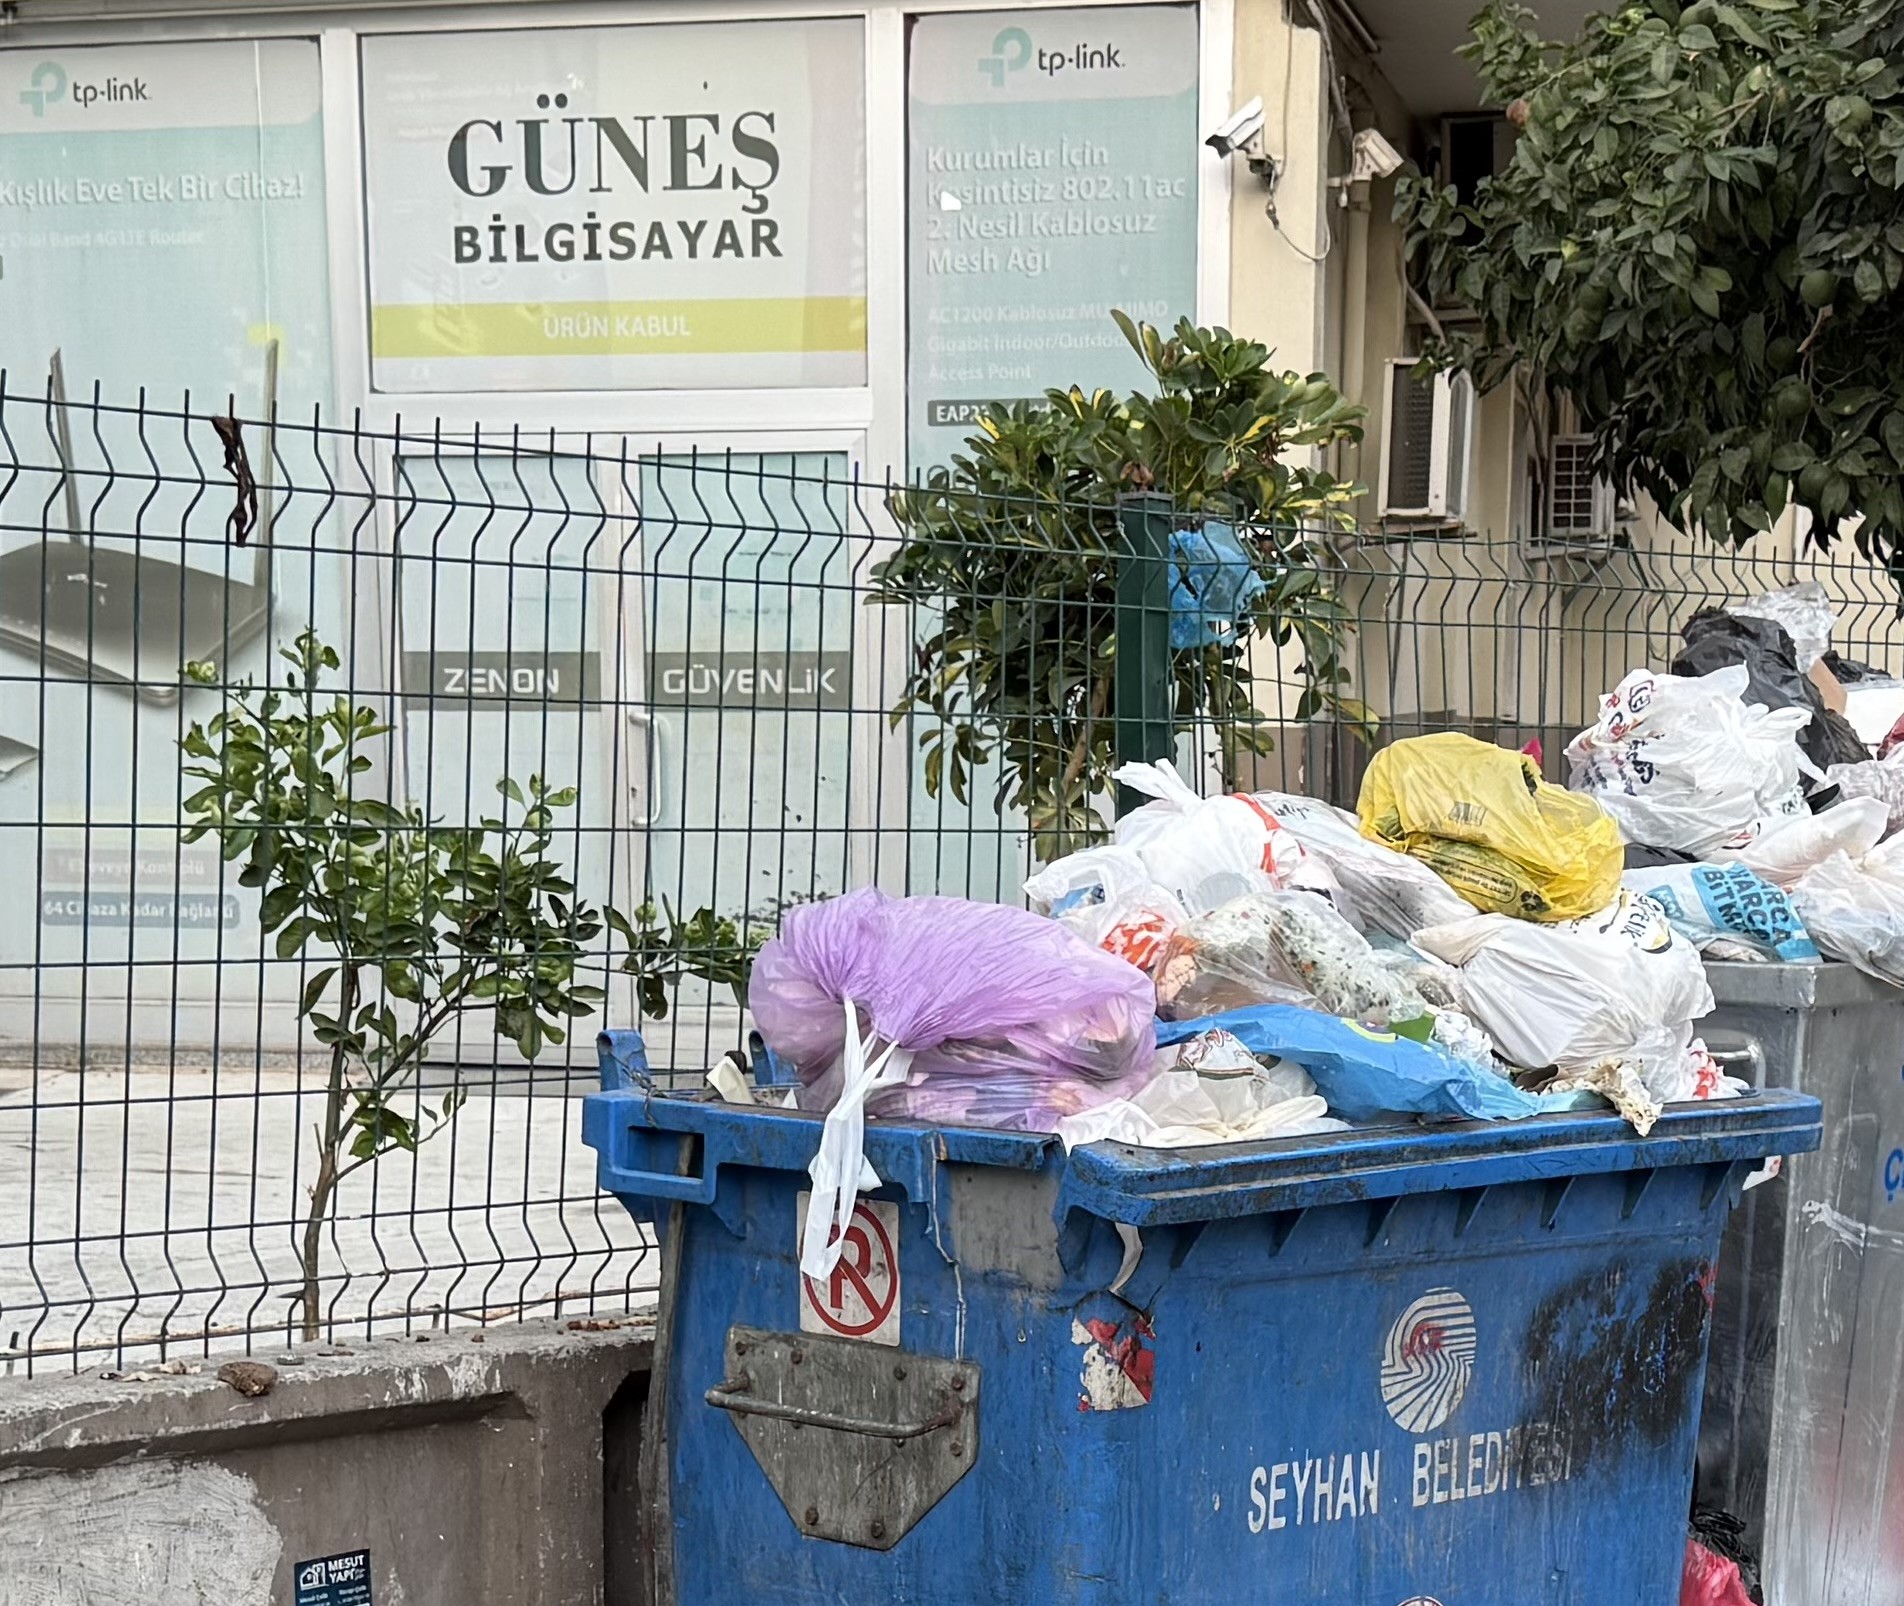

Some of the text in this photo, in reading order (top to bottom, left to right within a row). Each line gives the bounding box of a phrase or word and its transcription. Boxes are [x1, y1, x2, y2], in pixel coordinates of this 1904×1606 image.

[447, 93, 780, 214] GÜNEŞ
[926, 136, 1108, 172] Kurumlar İçin
[76, 179, 123, 203] Eve
[129, 177, 173, 201] Tek
[180, 175, 215, 200] Bir
[1062, 176, 1186, 200] 802.11ac
[455, 211, 783, 264] BİLGİSAYAR
[926, 209, 1157, 240] 2. Nesil Kablosuz
[927, 247, 1049, 278] Mesh Ağı
[616, 311, 691, 337] KABUL
[998, 304, 1074, 323] Kablosuz
[995, 333, 1127, 350] Indoor/Outdoo
[929, 365, 1031, 381] Access Point
[443, 667, 560, 693] ZENON
[1248, 1450, 1380, 1534] SEYHAN
[328, 1555, 364, 1571] MESUT
